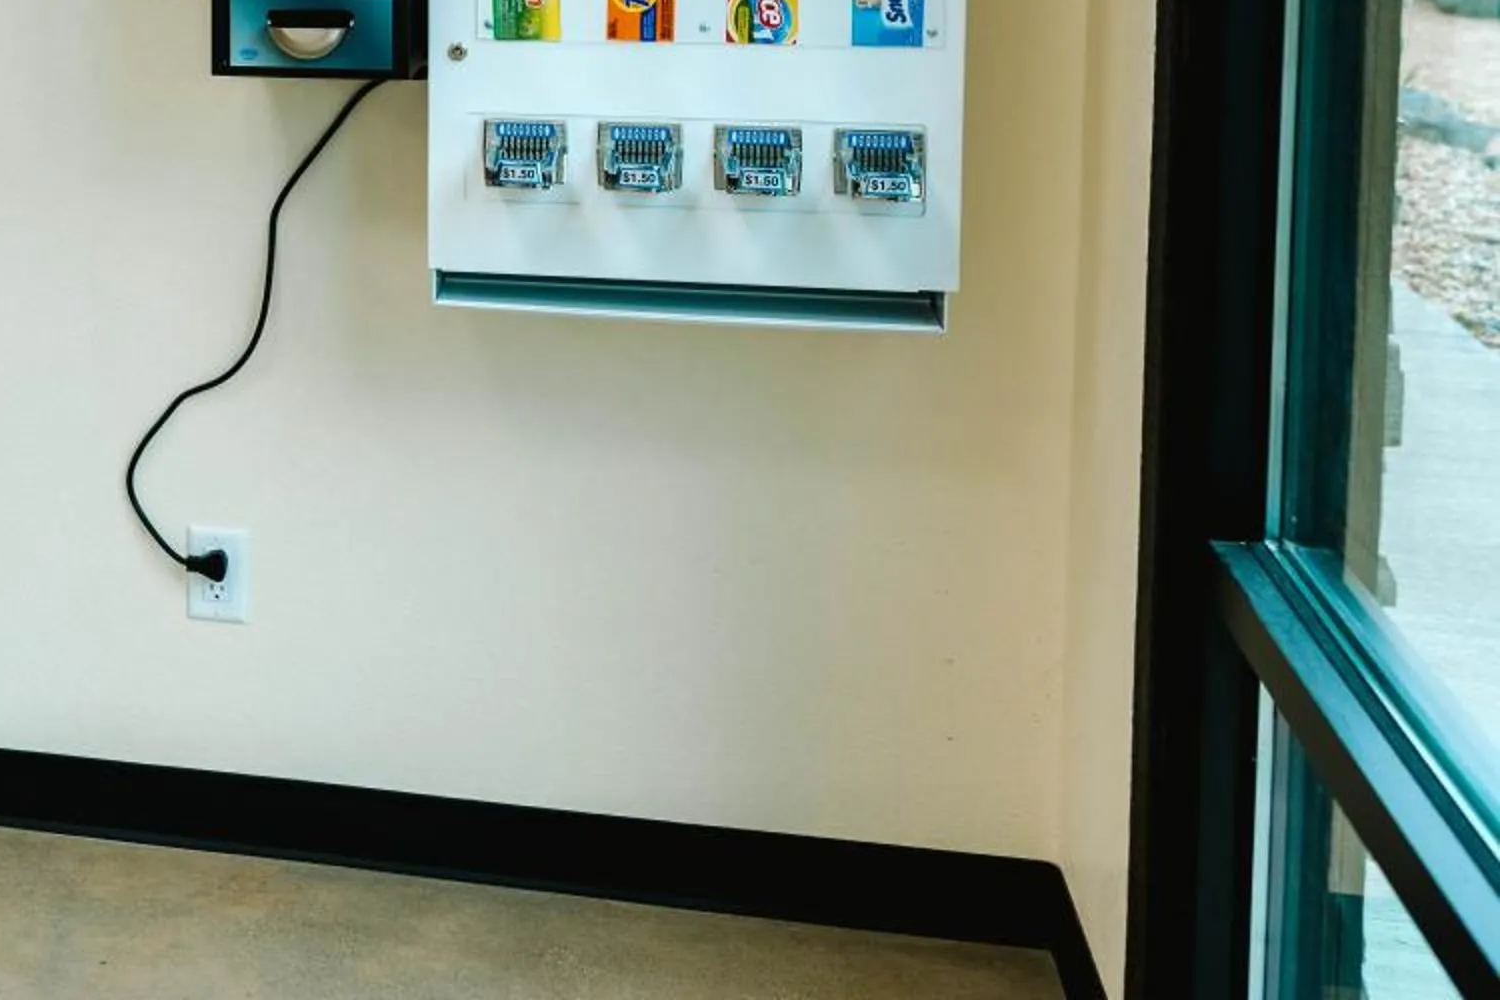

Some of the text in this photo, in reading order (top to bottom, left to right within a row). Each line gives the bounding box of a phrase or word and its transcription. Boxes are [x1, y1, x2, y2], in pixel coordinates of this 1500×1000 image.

[503, 169, 535, 180] $1.50
[622, 173, 656, 184] $1.50
[745, 175, 780, 187] $1.50
[871, 180, 906, 191] $1.50
